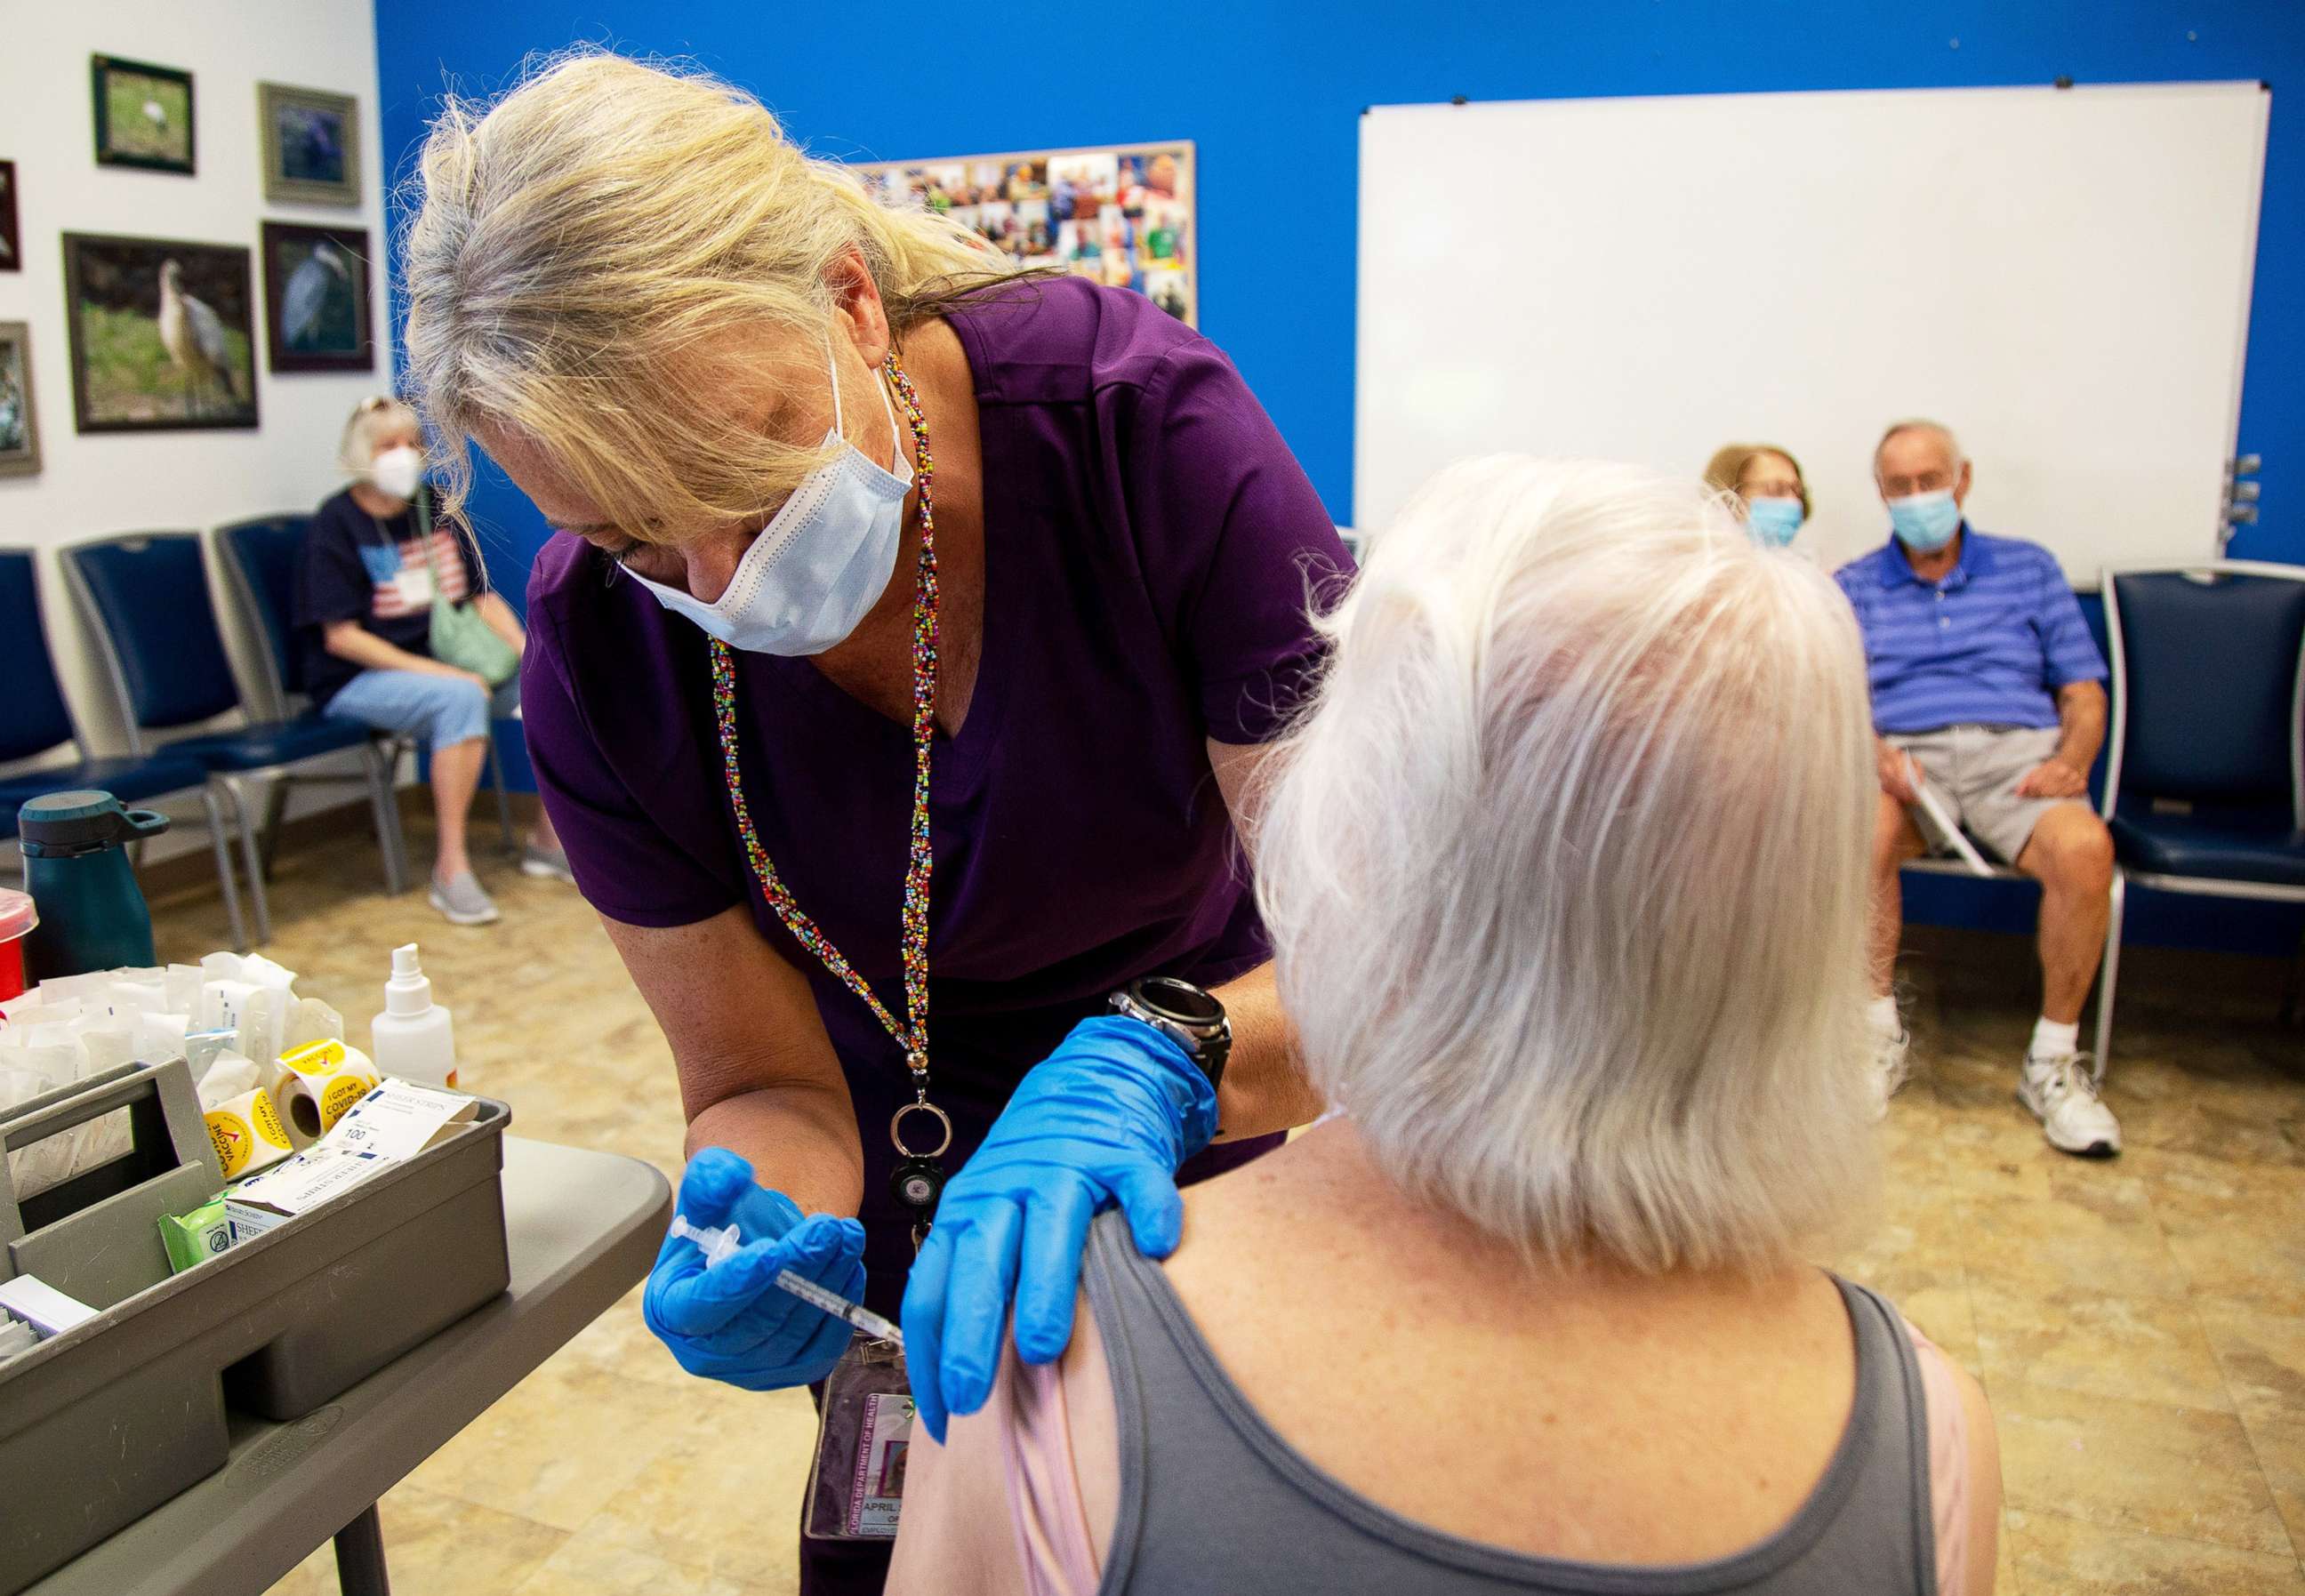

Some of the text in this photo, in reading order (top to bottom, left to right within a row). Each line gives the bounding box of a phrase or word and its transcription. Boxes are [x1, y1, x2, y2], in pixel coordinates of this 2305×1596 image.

[325, 1088, 367, 1115] COVID-19
[332, 1087, 346, 1099] GOT
[347, 1083, 357, 1092] MY
[213, 1123, 234, 1161] VACCINE
[345, 1128, 366, 1140] 100
[866, 1394, 878, 1431] HEALTH
[863, 1432, 873, 1442] OF
[855, 1443, 871, 1498] DEPARTMENT
[863, 1503, 896, 1512] APRIL
